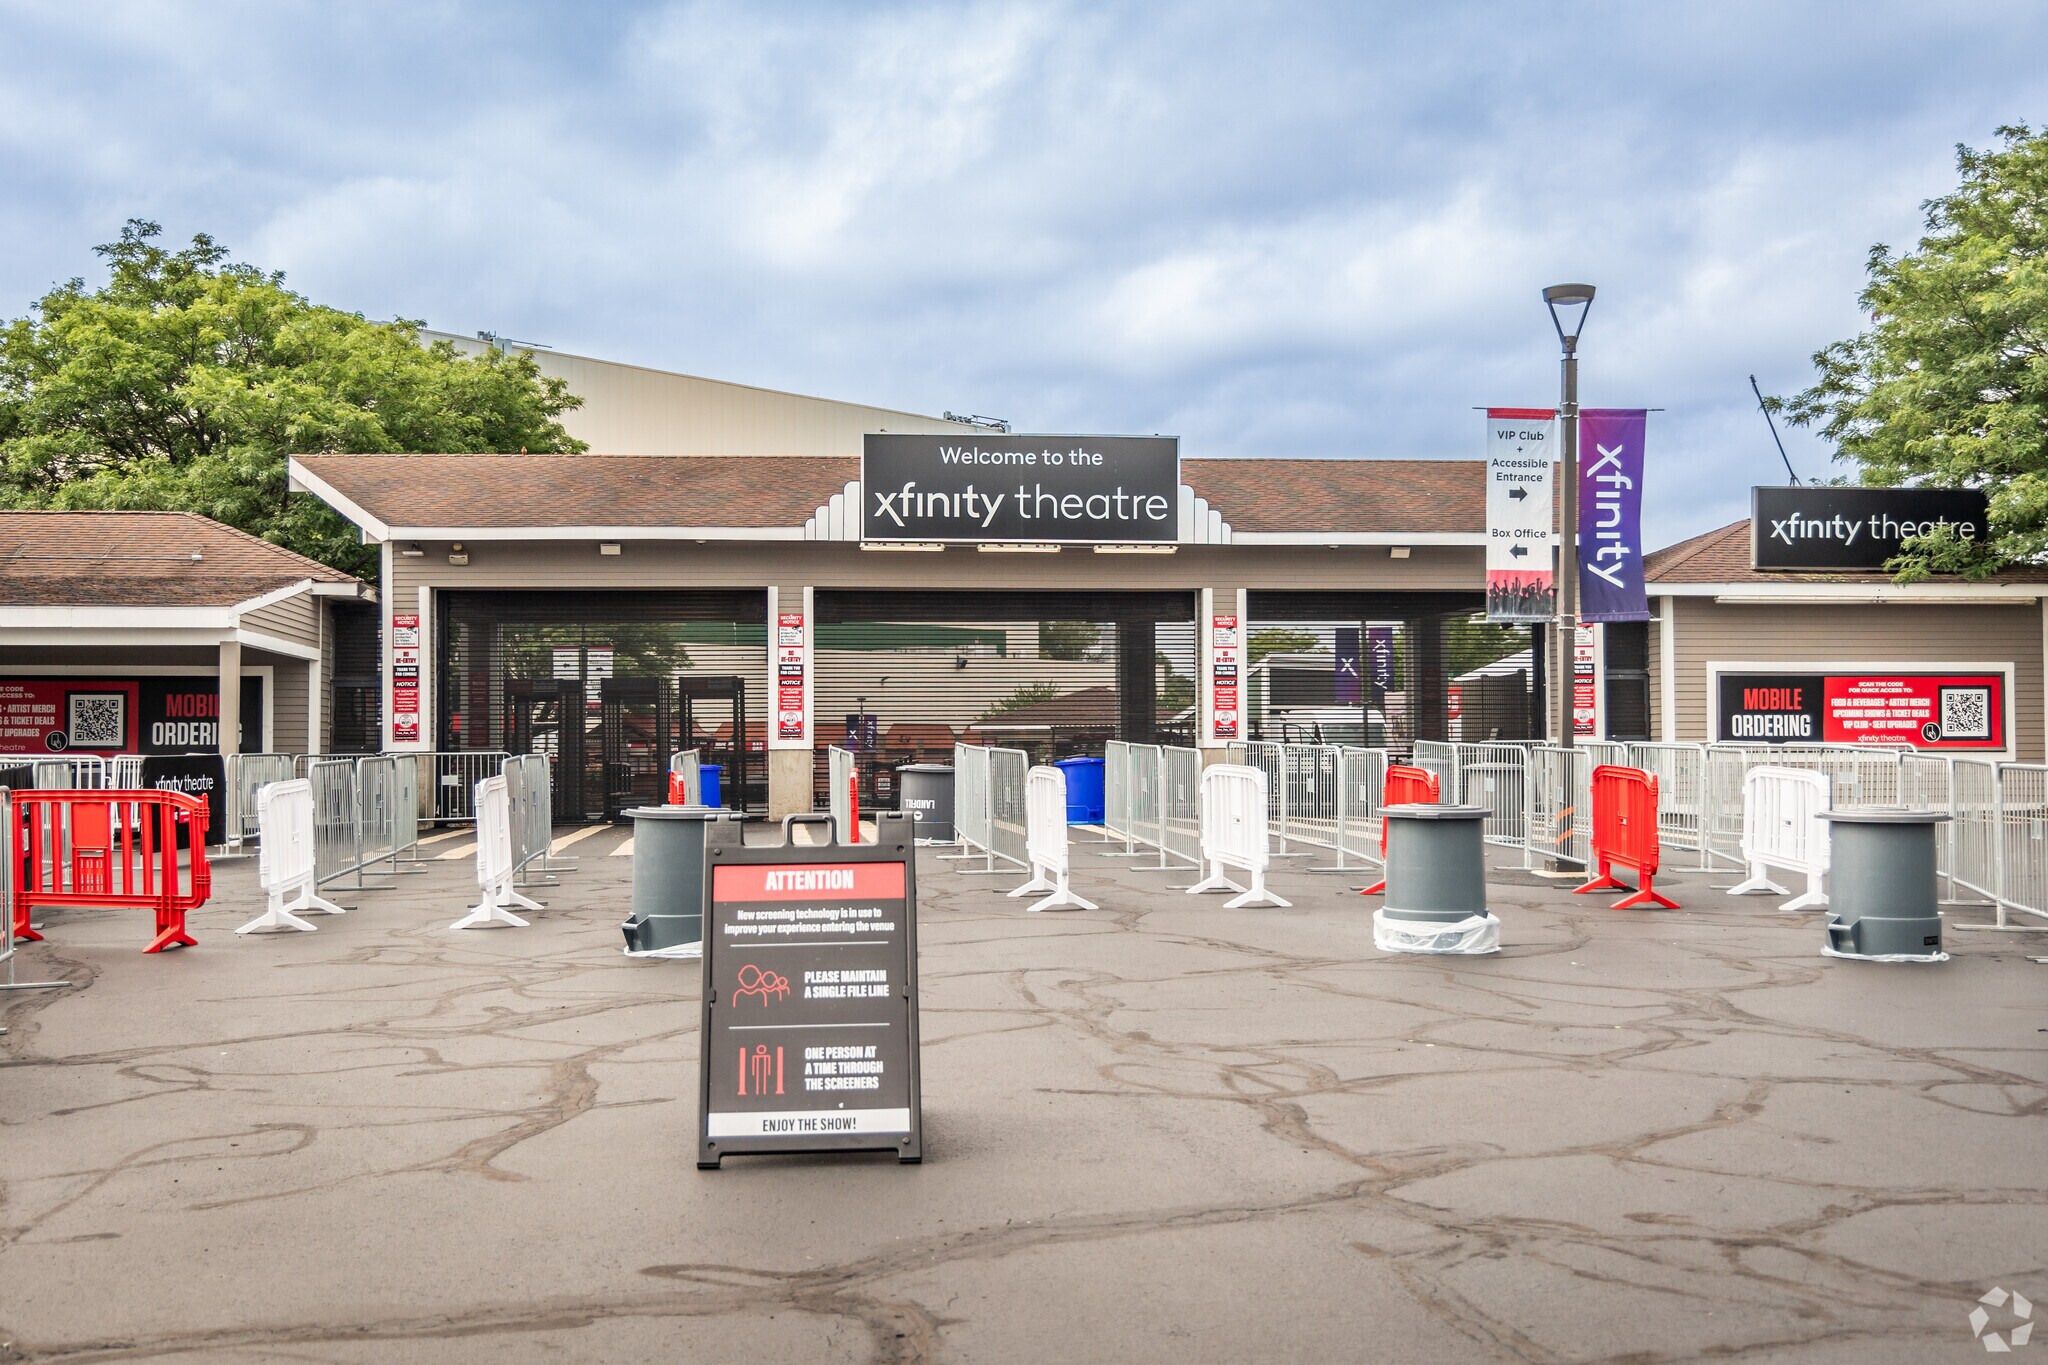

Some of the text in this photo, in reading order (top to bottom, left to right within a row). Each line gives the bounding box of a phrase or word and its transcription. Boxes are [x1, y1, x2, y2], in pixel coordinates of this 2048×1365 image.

[1497, 430, 1544, 441] VIP Club
[939, 446, 1103, 466] Welcome to the
[1492, 458, 1548, 468] Accessible
[1496, 472, 1543, 482] Entrance
[874, 482, 1168, 528] xfinity theatre
[1587, 443, 1632, 588] xfinity
[1492, 528, 1547, 538] Box Office
[1770, 512, 1976, 546] xfinity theatre
[166, 694, 219, 717] MOBIL
[1744, 688, 1802, 710] MOBILE
[1831, 698, 1930, 706] FOOD & BEVERAGES ARTIST MERCH
[7, 705, 30, 713] ARTIST
[32, 705, 55, 713] MERCH
[1833, 709, 1930, 718] UPCOMING SHOWS & TICKET DEALS
[4, 717, 55, 725] & TICKET DEALS
[1732, 714, 1811, 737] ORDERING
[5, 728, 39, 737] UPGRADES
[184, 773, 214, 791] theatre
[765, 870, 854, 891] ATTENTION
[737, 907, 882, 922] New screening technology is in use to
[724, 921, 894, 936] improve your experience entering the venue
[804, 970, 886, 983] PLEASE MAINTAIN
[804, 985, 889, 998] A SINGLE FILE LINE
[805, 1046, 876, 1059] ONE PERSON AT
[805, 1061, 883, 1075] A TIME THROUGH
[805, 1076, 879, 1090] THE SCREENERS
[763, 1117, 856, 1132] ENJOY THE SHOW!
